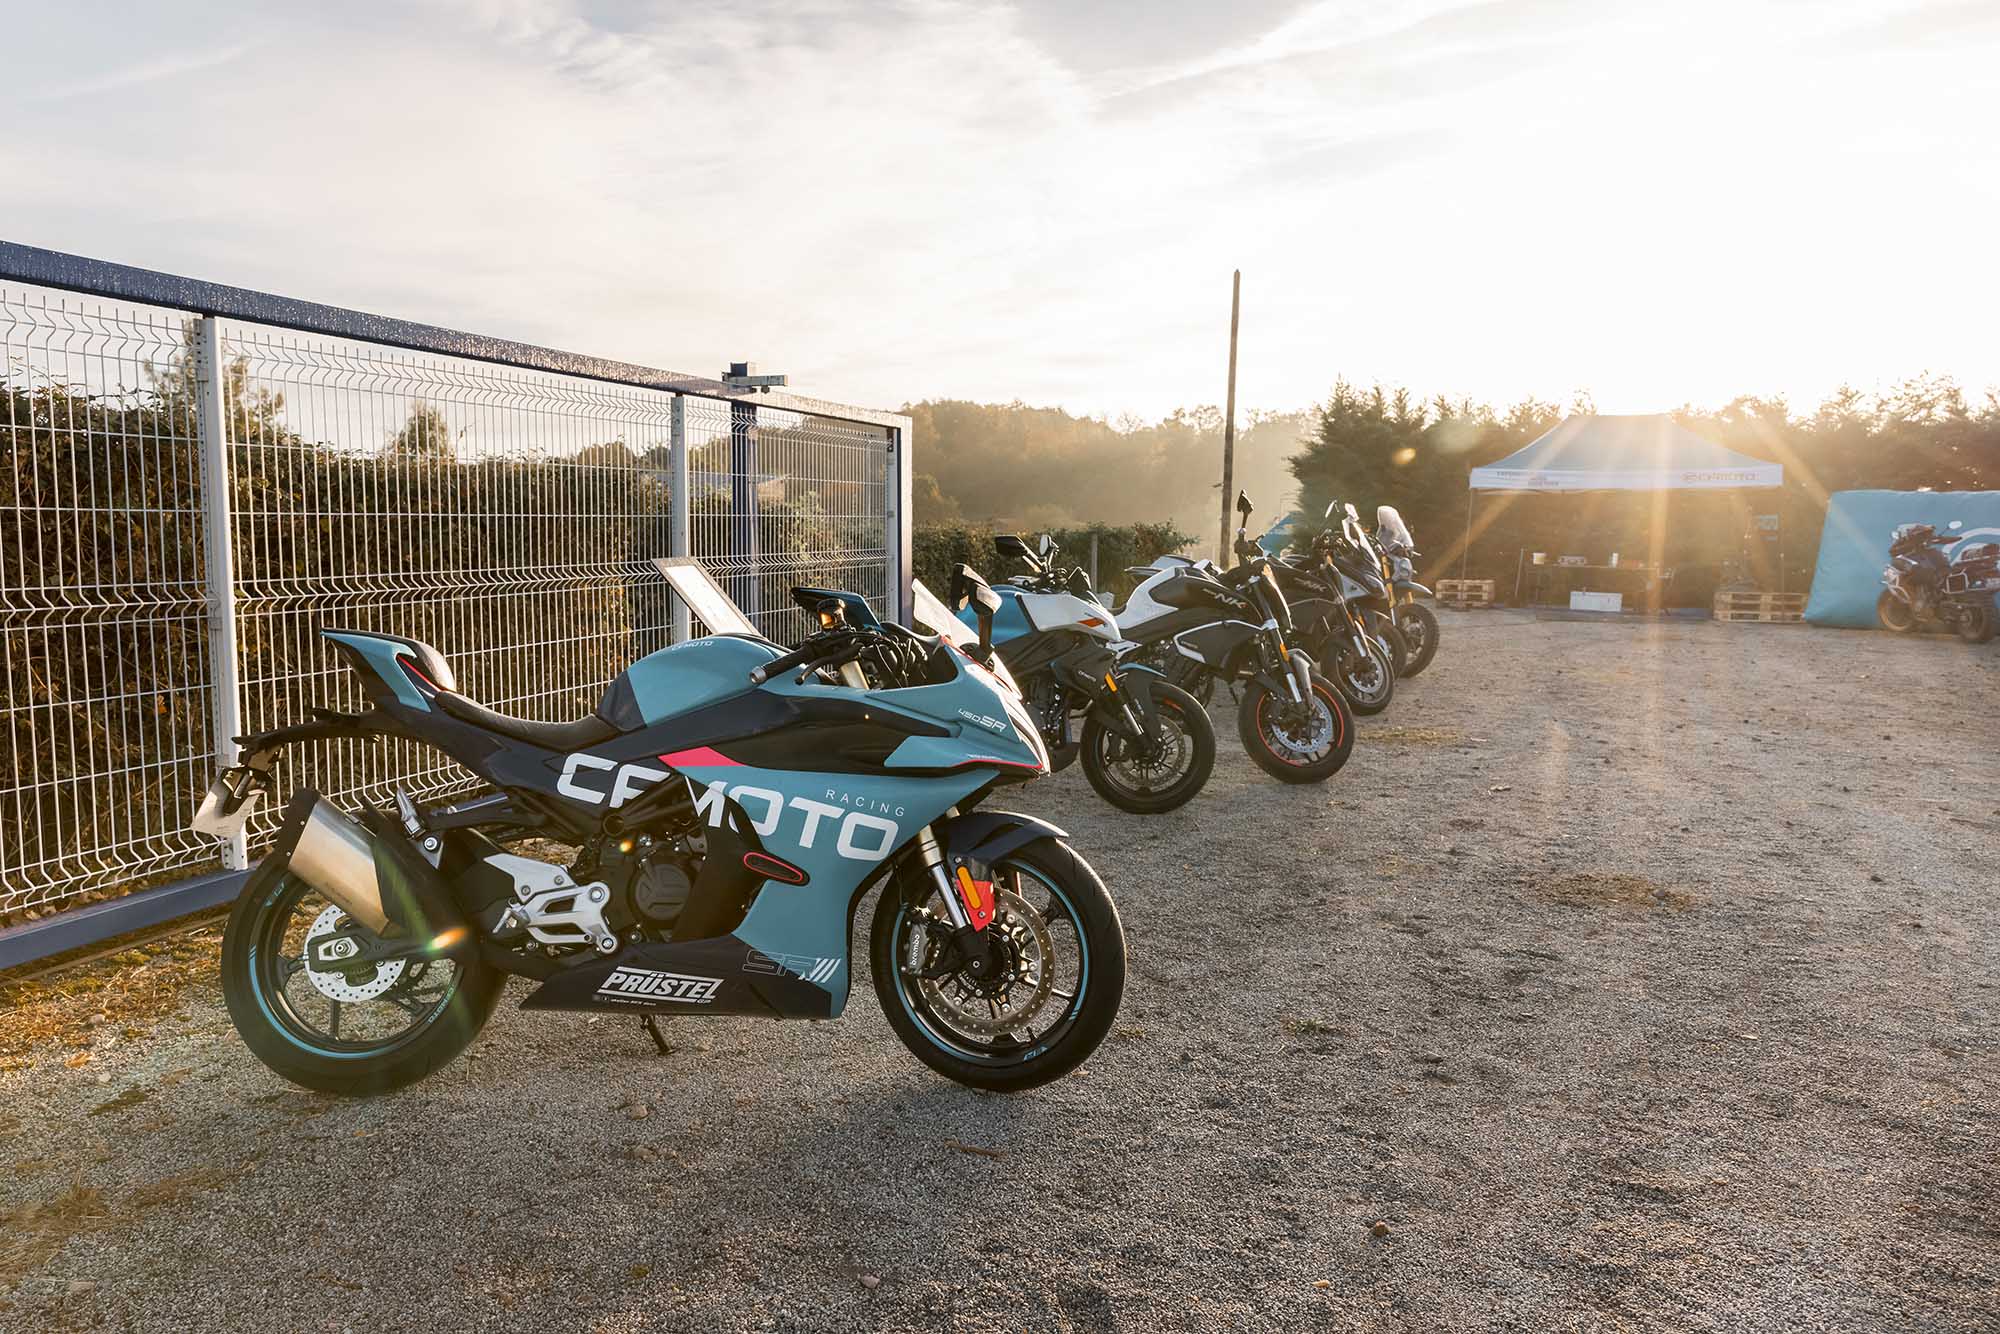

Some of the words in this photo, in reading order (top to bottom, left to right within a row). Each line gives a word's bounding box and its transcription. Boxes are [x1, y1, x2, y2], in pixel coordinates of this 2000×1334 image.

[958, 707, 1007, 732] 450SR
[825, 788, 905, 817] RACING
[910, 934, 920, 966] brembo
[600, 971, 724, 1000] PRÜSTEL
